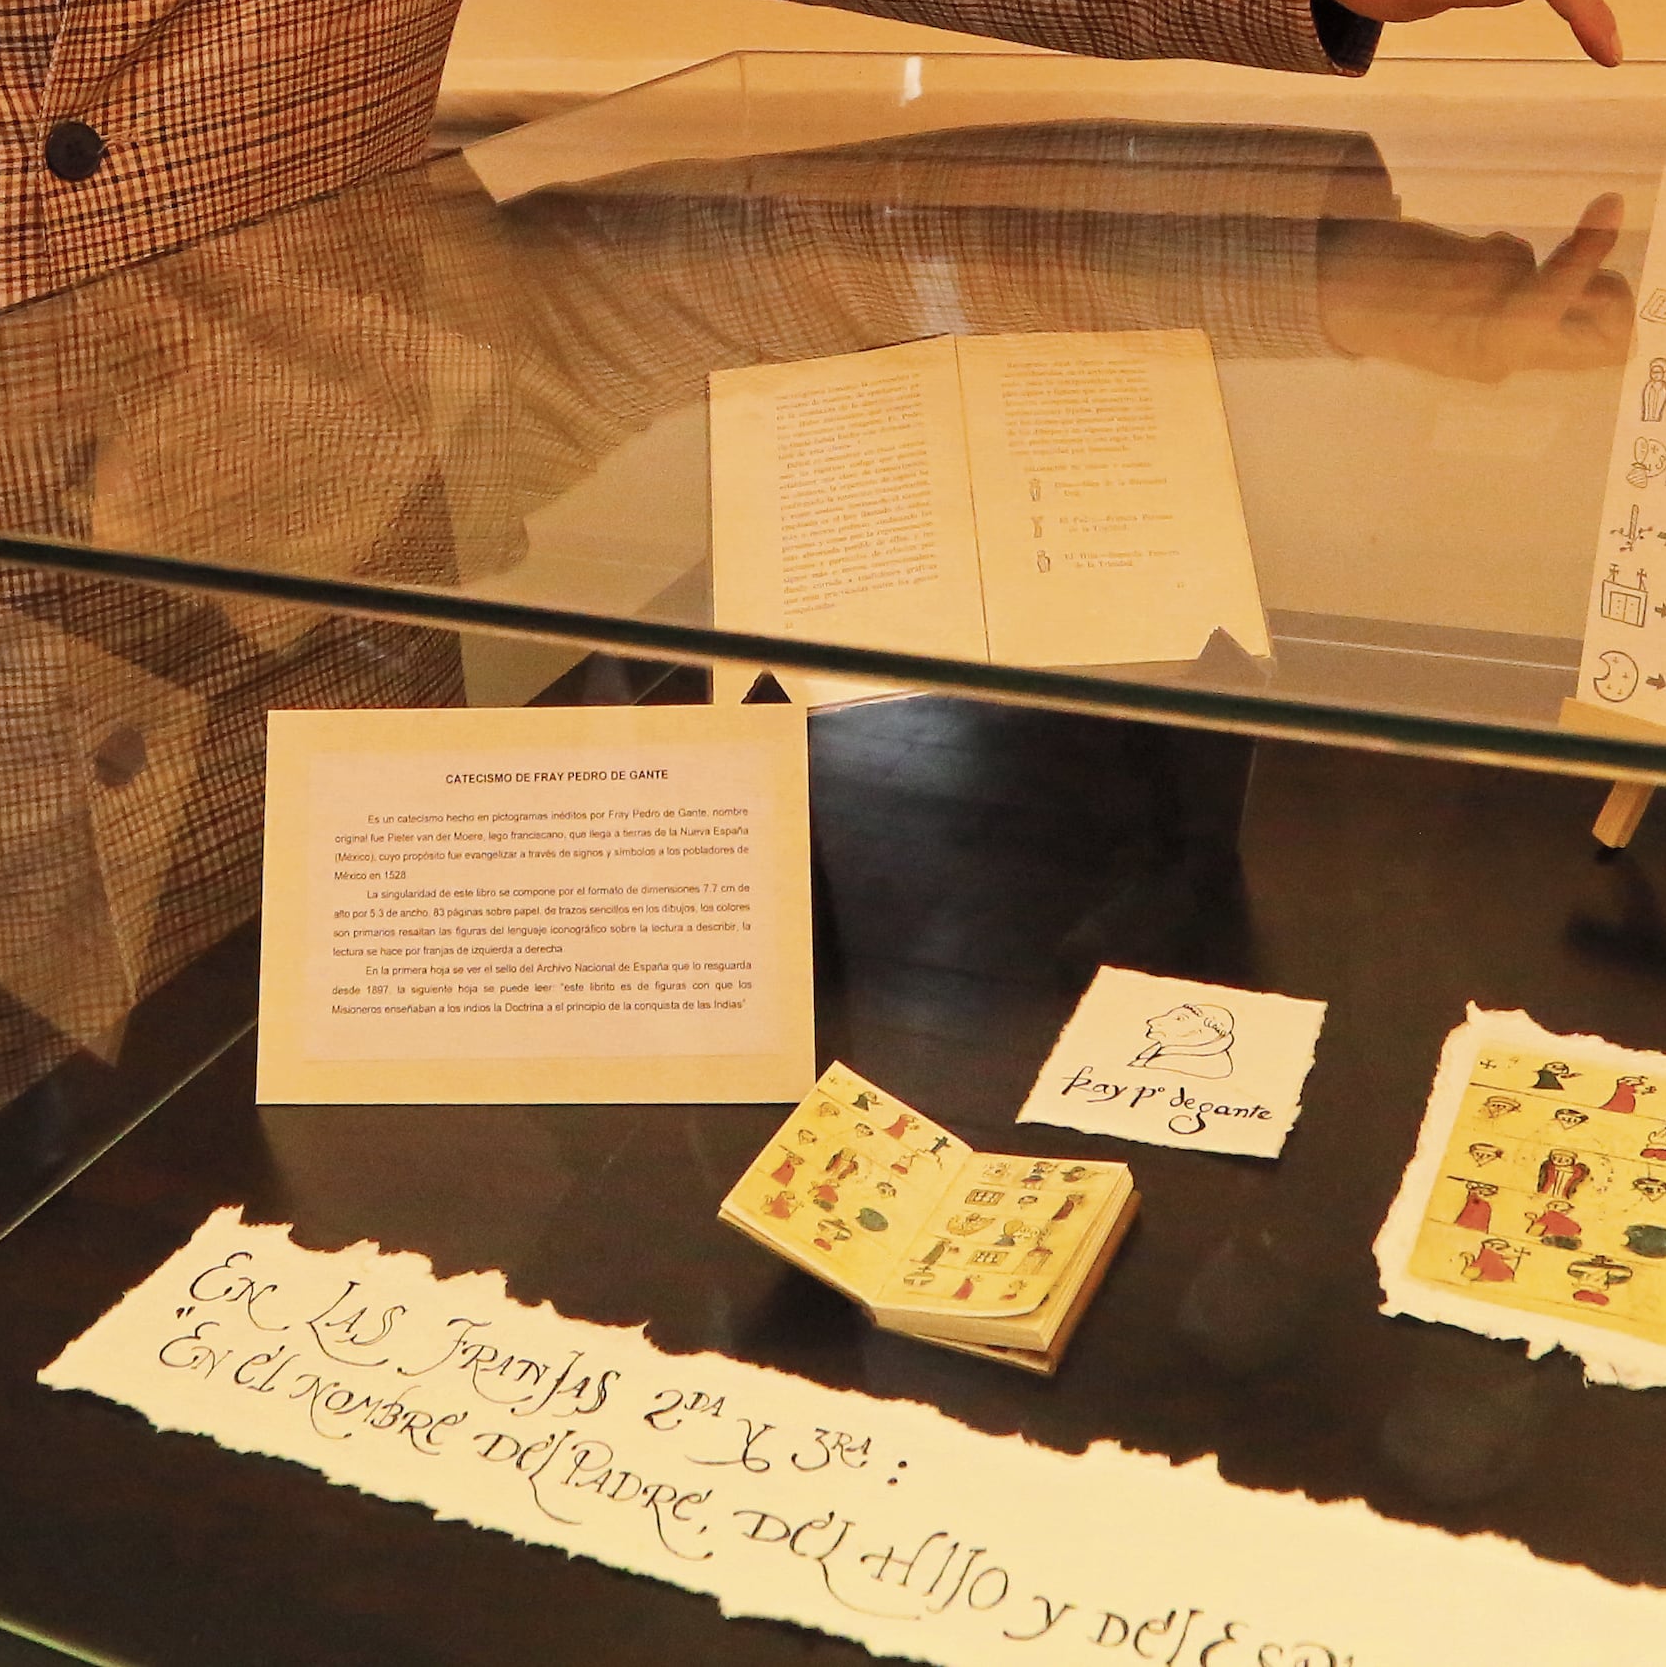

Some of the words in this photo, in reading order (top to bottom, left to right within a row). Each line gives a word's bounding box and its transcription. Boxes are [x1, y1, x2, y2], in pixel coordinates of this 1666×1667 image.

[446, 773, 512, 784] CATECISMO
[516, 773, 530, 782] DE
[534, 772, 564, 782] FRAY
[568, 771, 607, 781] PEDRO
[611, 771, 625, 780] DE
[629, 769, 668, 779] GANTE
[590, 812, 605, 821] por
[663, 810, 675, 818] de
[439, 889, 451, 898] de
[558, 888, 574, 897] por
[576, 886, 585, 895] el
[626, 886, 638, 894] de
[738, 883, 750, 892] de
[405, 948, 420, 957] por
[456, 946, 469, 955] de
[381, 966, 389, 975] la
[484, 964, 493, 973] el
[618, 963, 630, 972] de
[672, 963, 690, 973] que
[397, 985, 405, 994] la
[637, 982, 649, 991] de
[692, 982, 710, 990] con
[715, 982, 733, 991] que
[738, 980, 752, 989] los
[447, 1004, 461, 1013] los
[494, 1003, 502, 1012] la
[555, 1002, 564, 1012] el
[608, 1002, 620, 1011] de
[623, 1002, 631, 1010] la
[682, 1001, 694, 1010] de
